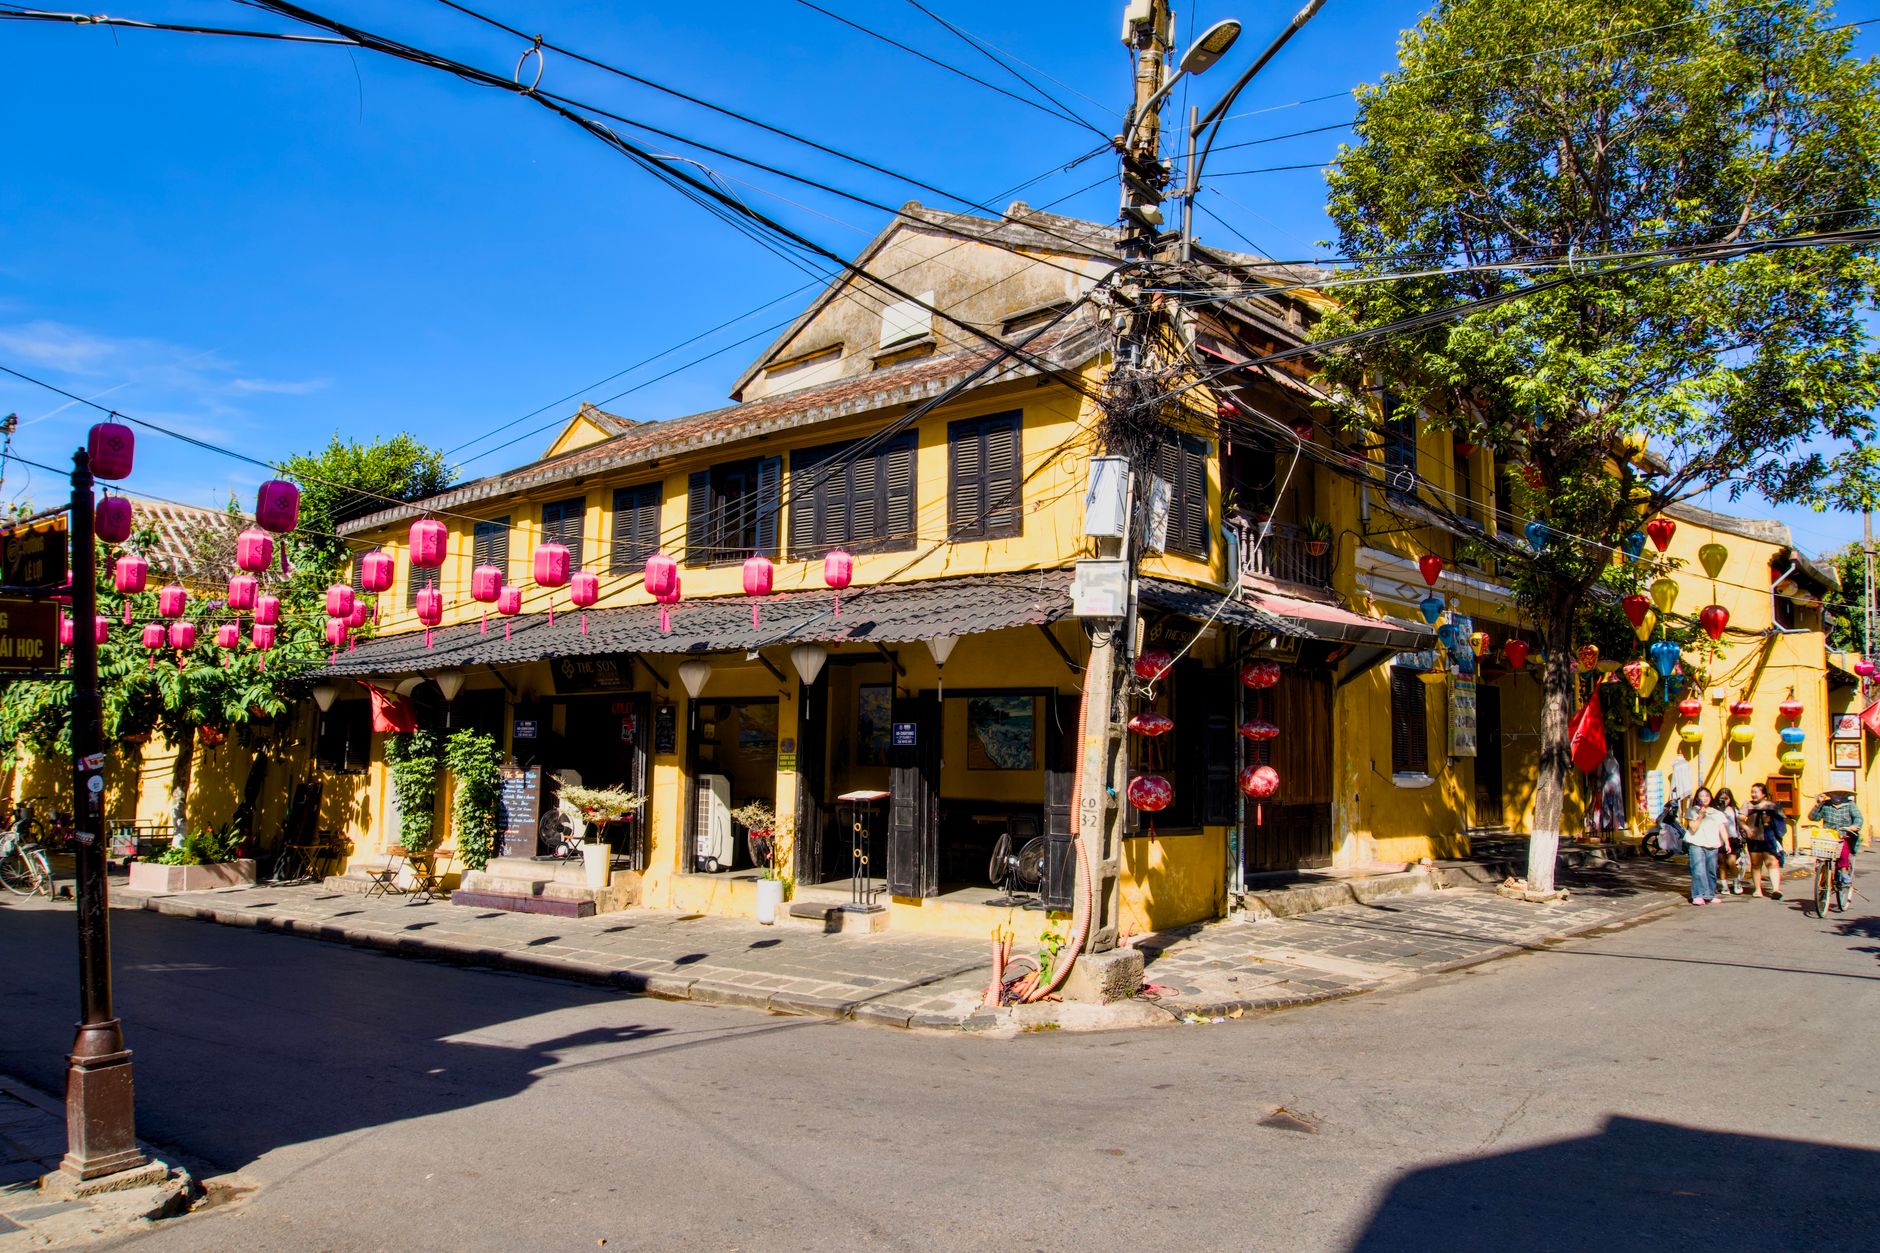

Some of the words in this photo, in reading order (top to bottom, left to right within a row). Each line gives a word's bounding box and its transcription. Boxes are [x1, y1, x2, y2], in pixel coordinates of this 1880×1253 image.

[1164, 629, 1180, 641] THE
[16, 637, 44, 661] HỌC
[575, 662, 594, 673] THE
[597, 660, 617, 672] SON
